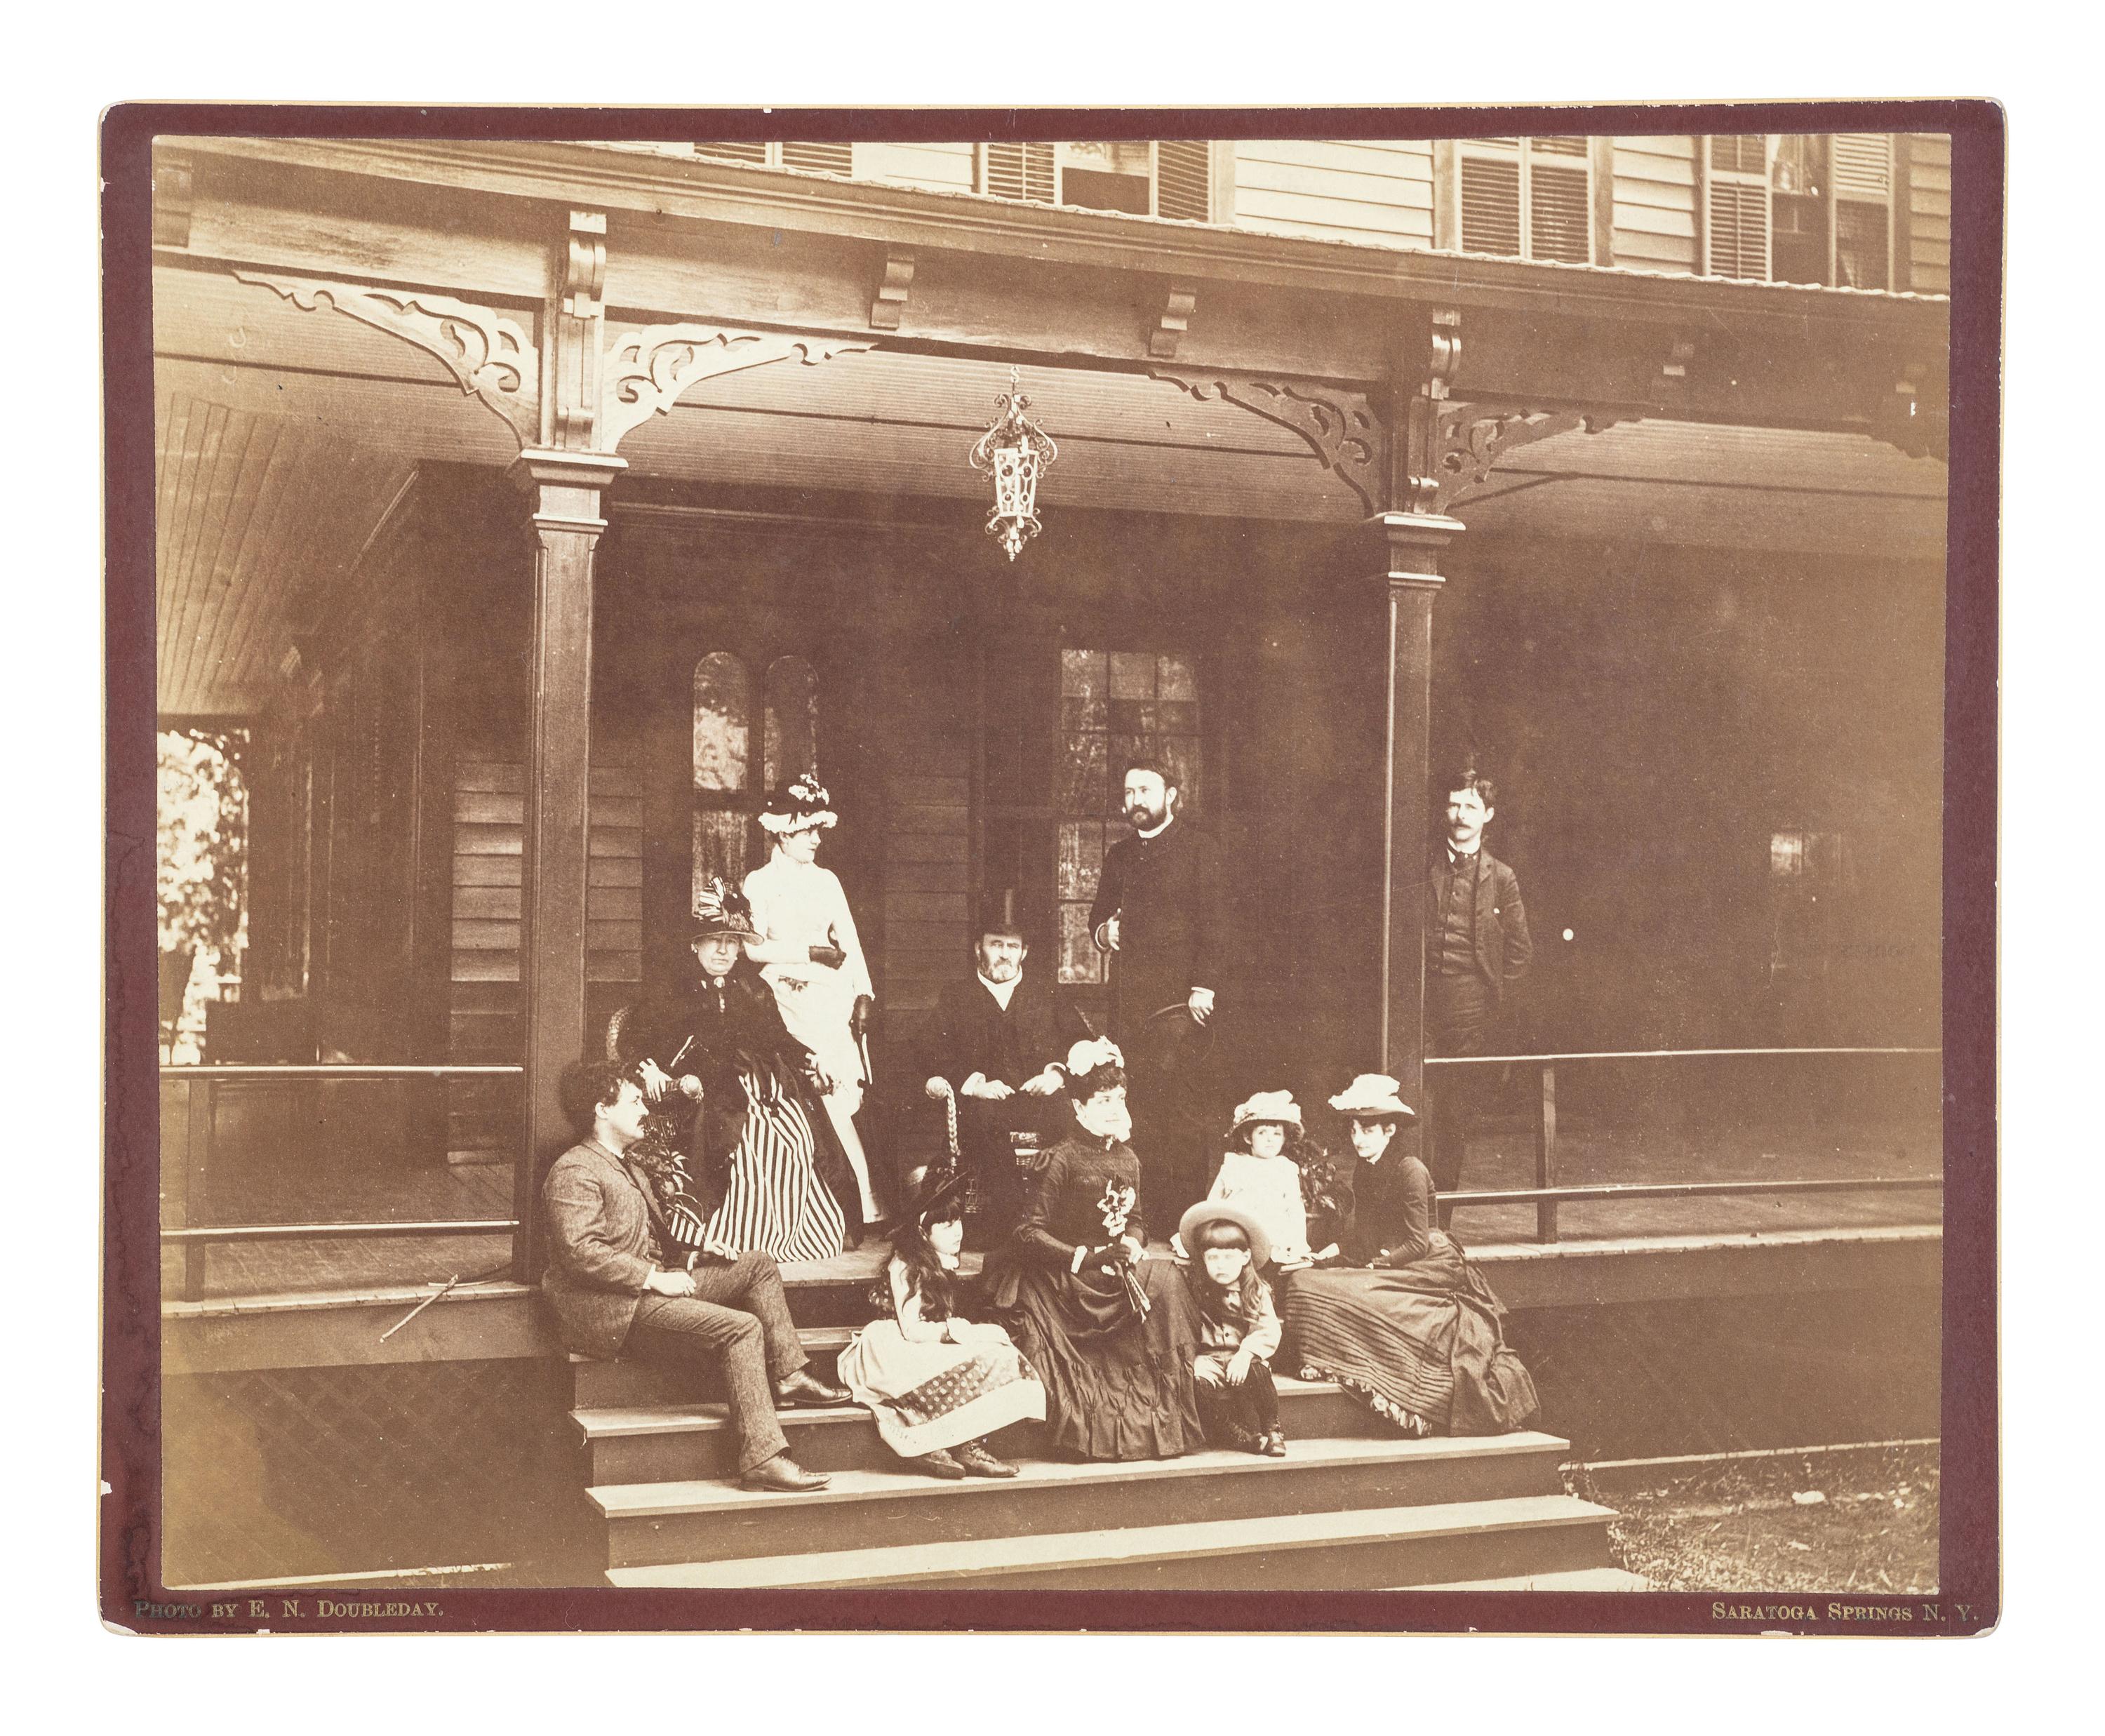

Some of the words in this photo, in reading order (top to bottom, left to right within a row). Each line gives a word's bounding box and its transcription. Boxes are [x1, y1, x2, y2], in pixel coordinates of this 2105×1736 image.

[212, 1604, 238, 1618] BY
[248, 1601, 270, 1618] E.
[282, 1600, 305, 1618] N.
[1923, 1604, 1946, 1621] N.
[1956, 1604, 1979, 1622] Y.
